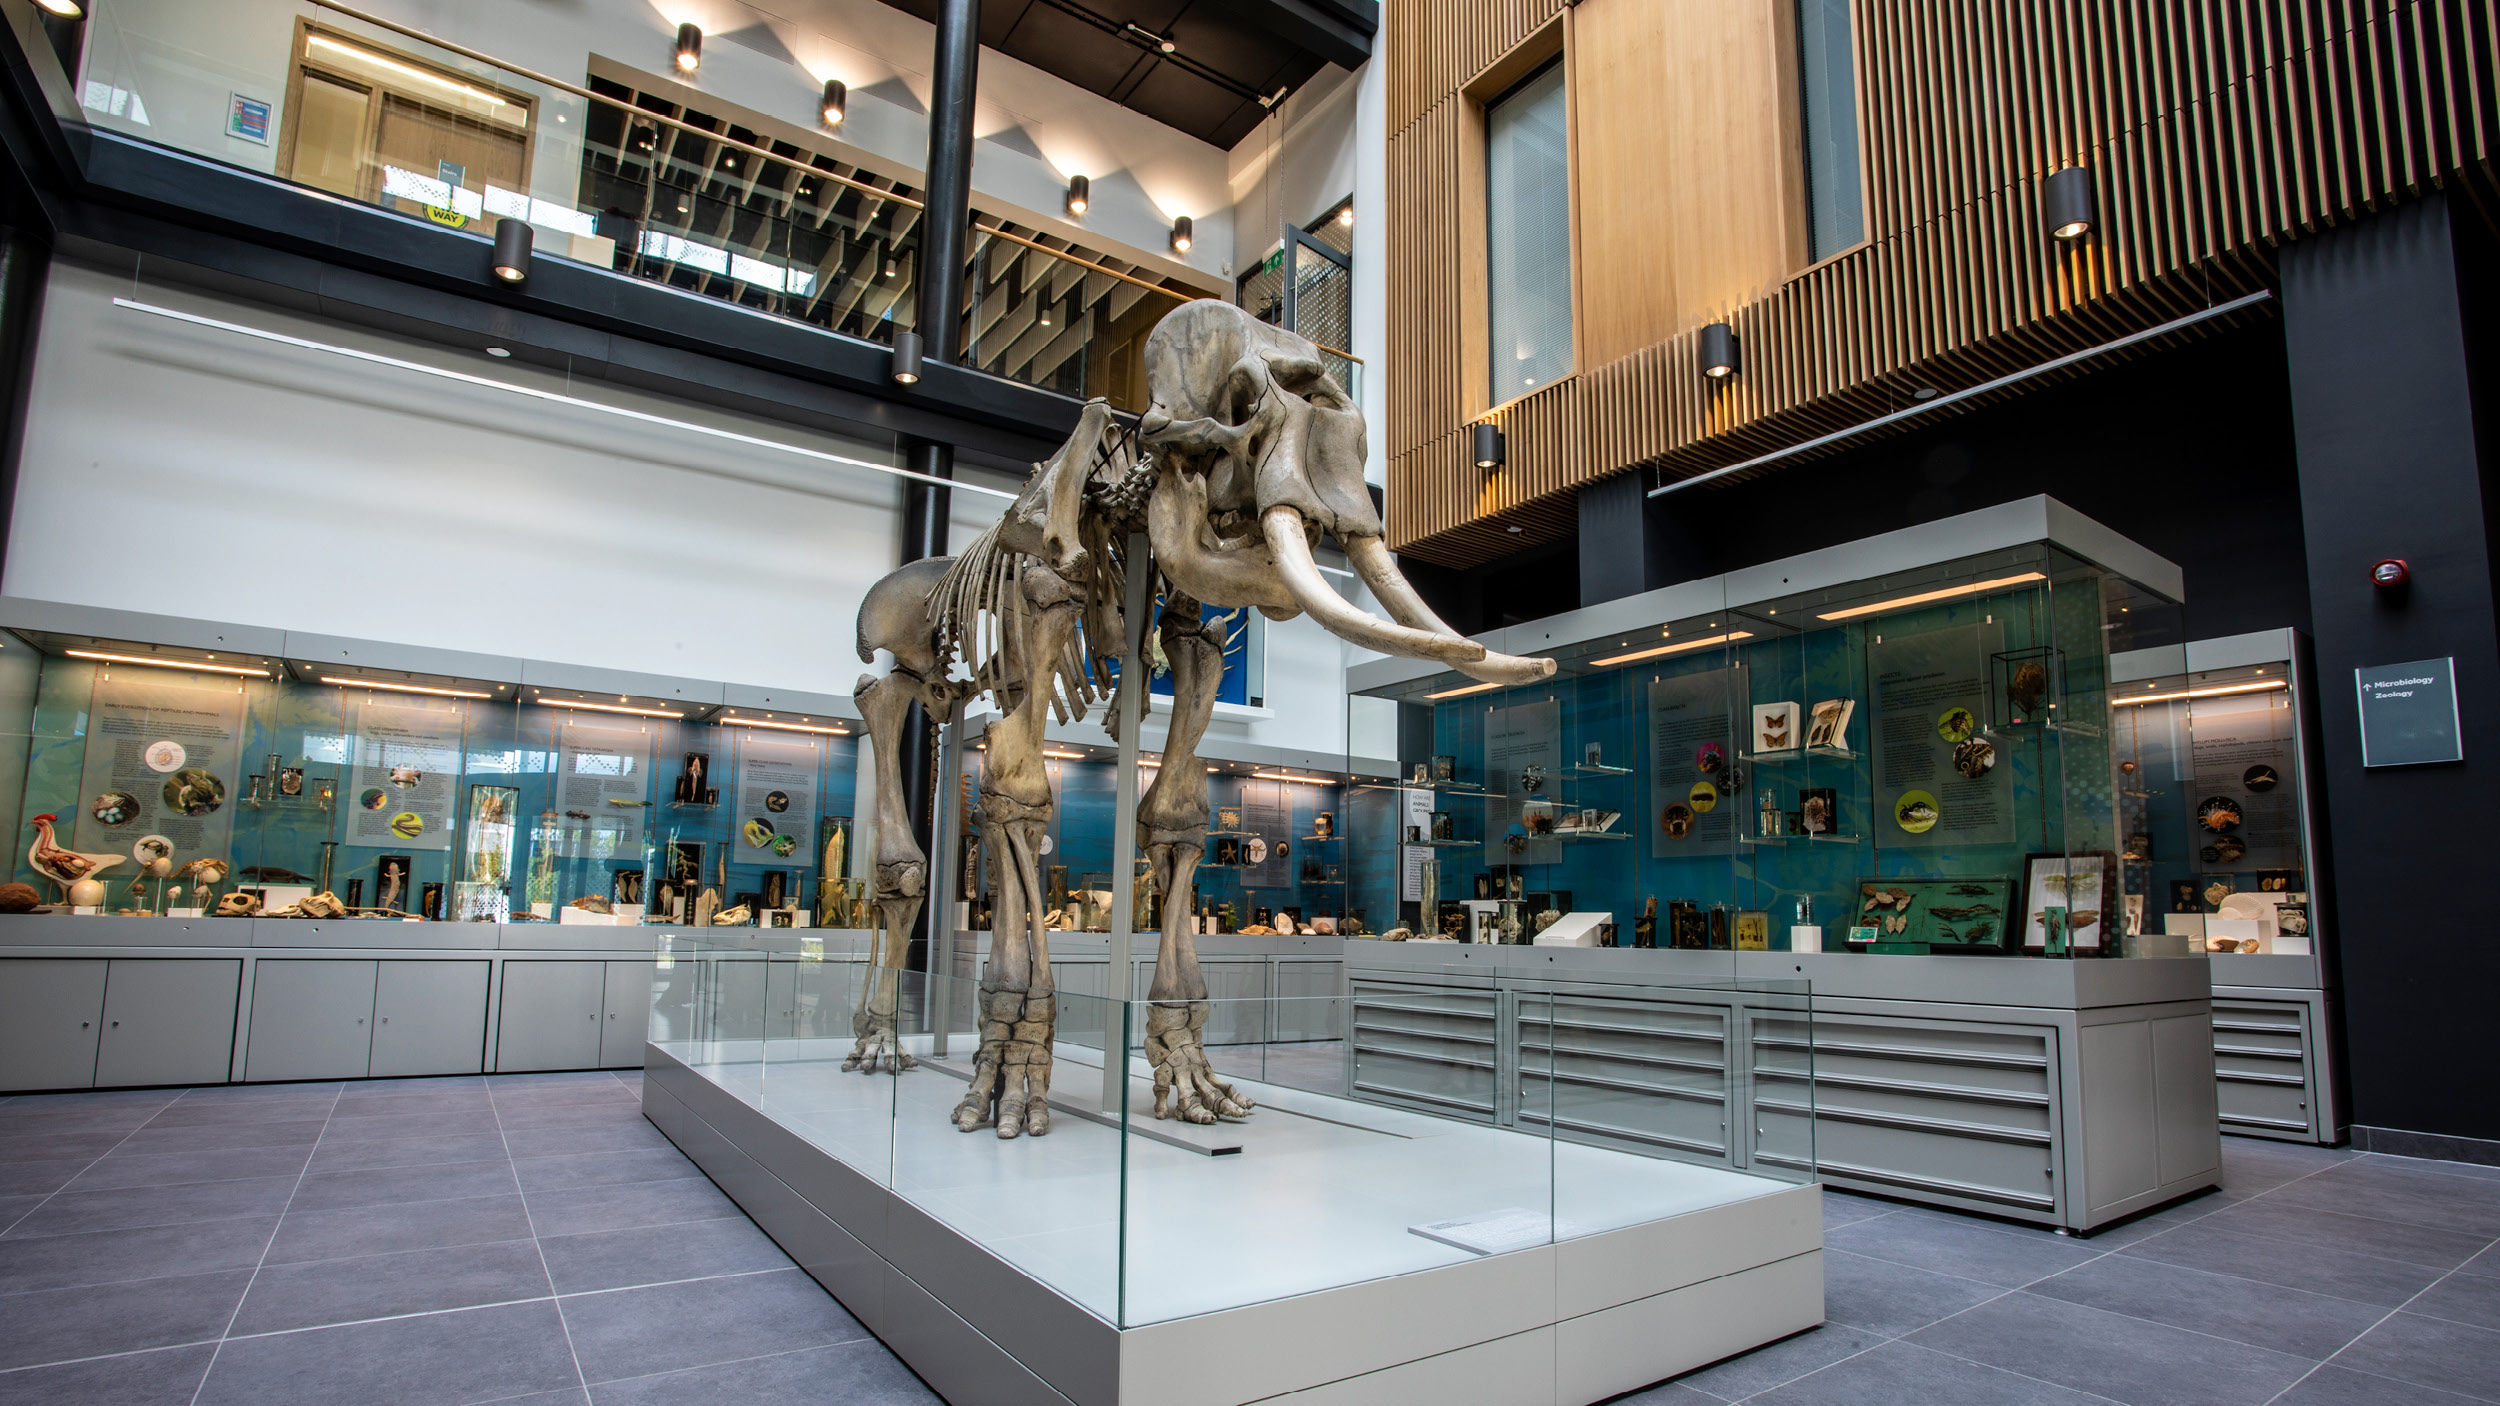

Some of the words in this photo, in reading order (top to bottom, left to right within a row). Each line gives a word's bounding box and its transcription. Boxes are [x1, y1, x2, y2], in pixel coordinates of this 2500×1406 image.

[441, 168, 458, 177] Stairs
[433, 209, 459, 223] WAY
[2374, 676, 2435, 689] Microbiology
[2375, 690, 2414, 699] Zoology
